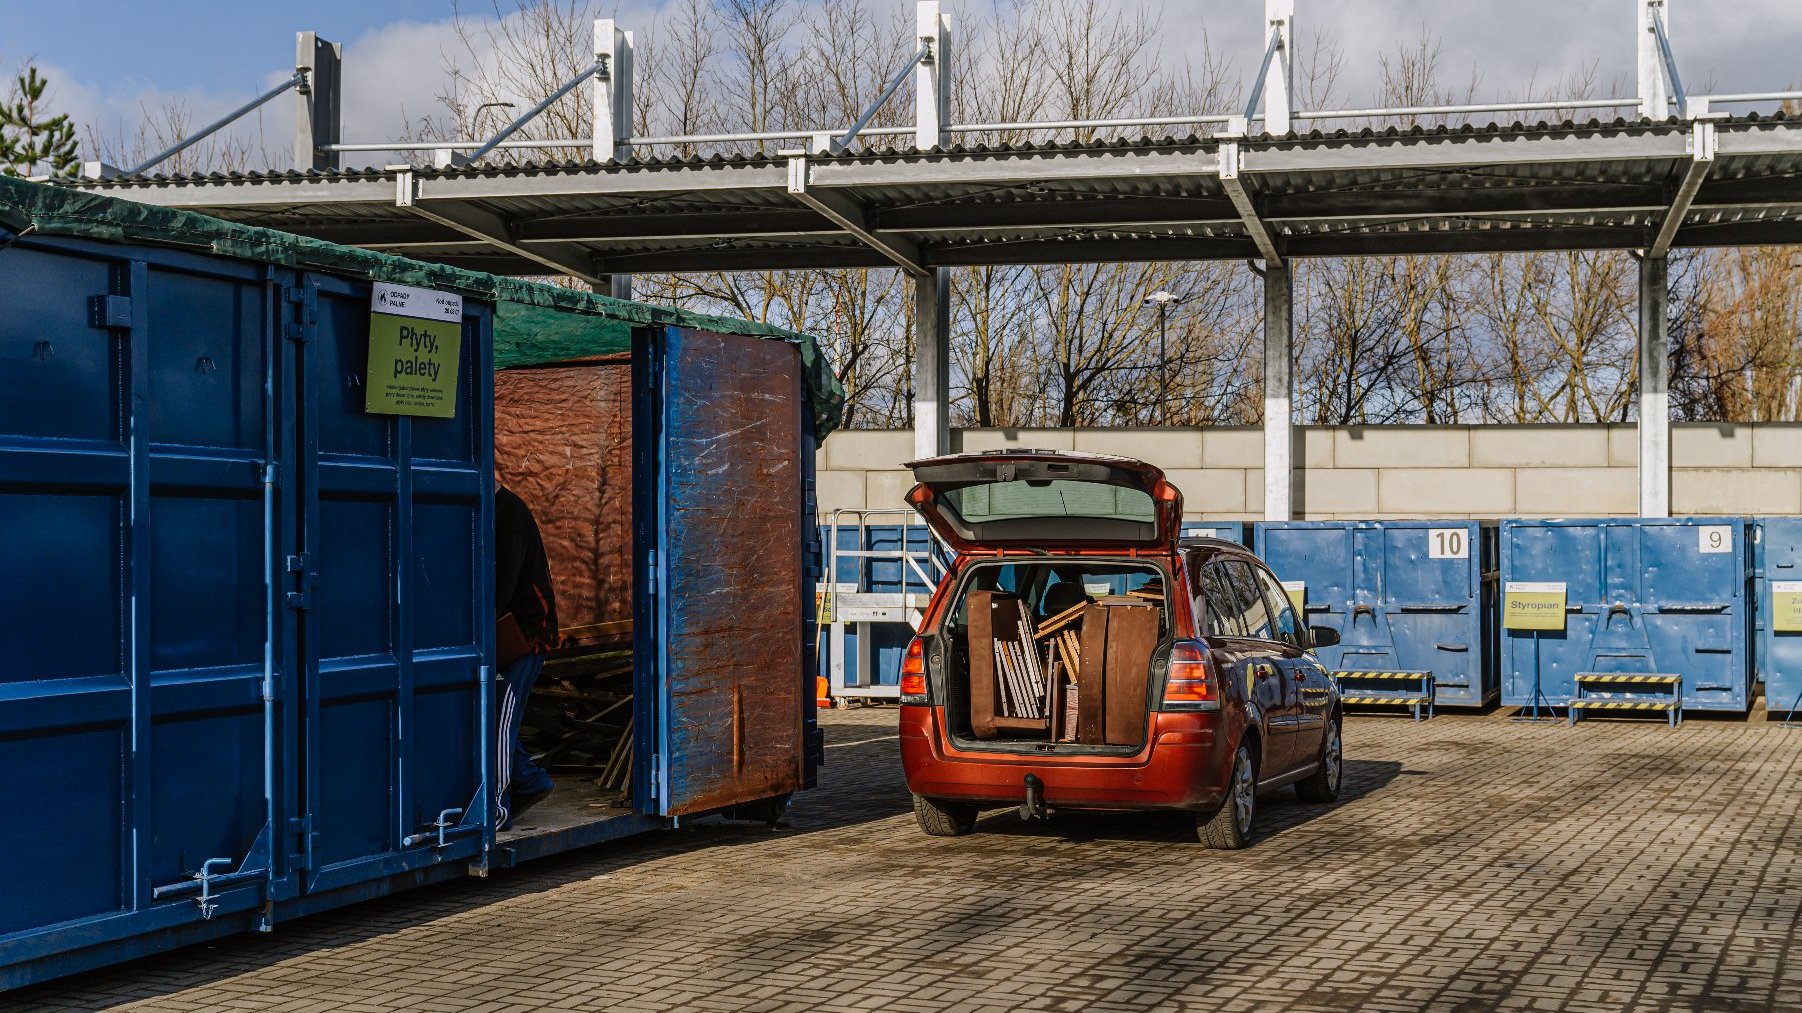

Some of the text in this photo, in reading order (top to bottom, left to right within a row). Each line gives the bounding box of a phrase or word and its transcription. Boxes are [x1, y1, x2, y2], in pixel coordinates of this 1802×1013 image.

[399, 325, 438, 354] Płyty,
[393, 356, 440, 382] palety
[1436, 532, 1461, 556] 10
[1709, 531, 1721, 548] 9
[1511, 600, 1558, 610] Styropian
